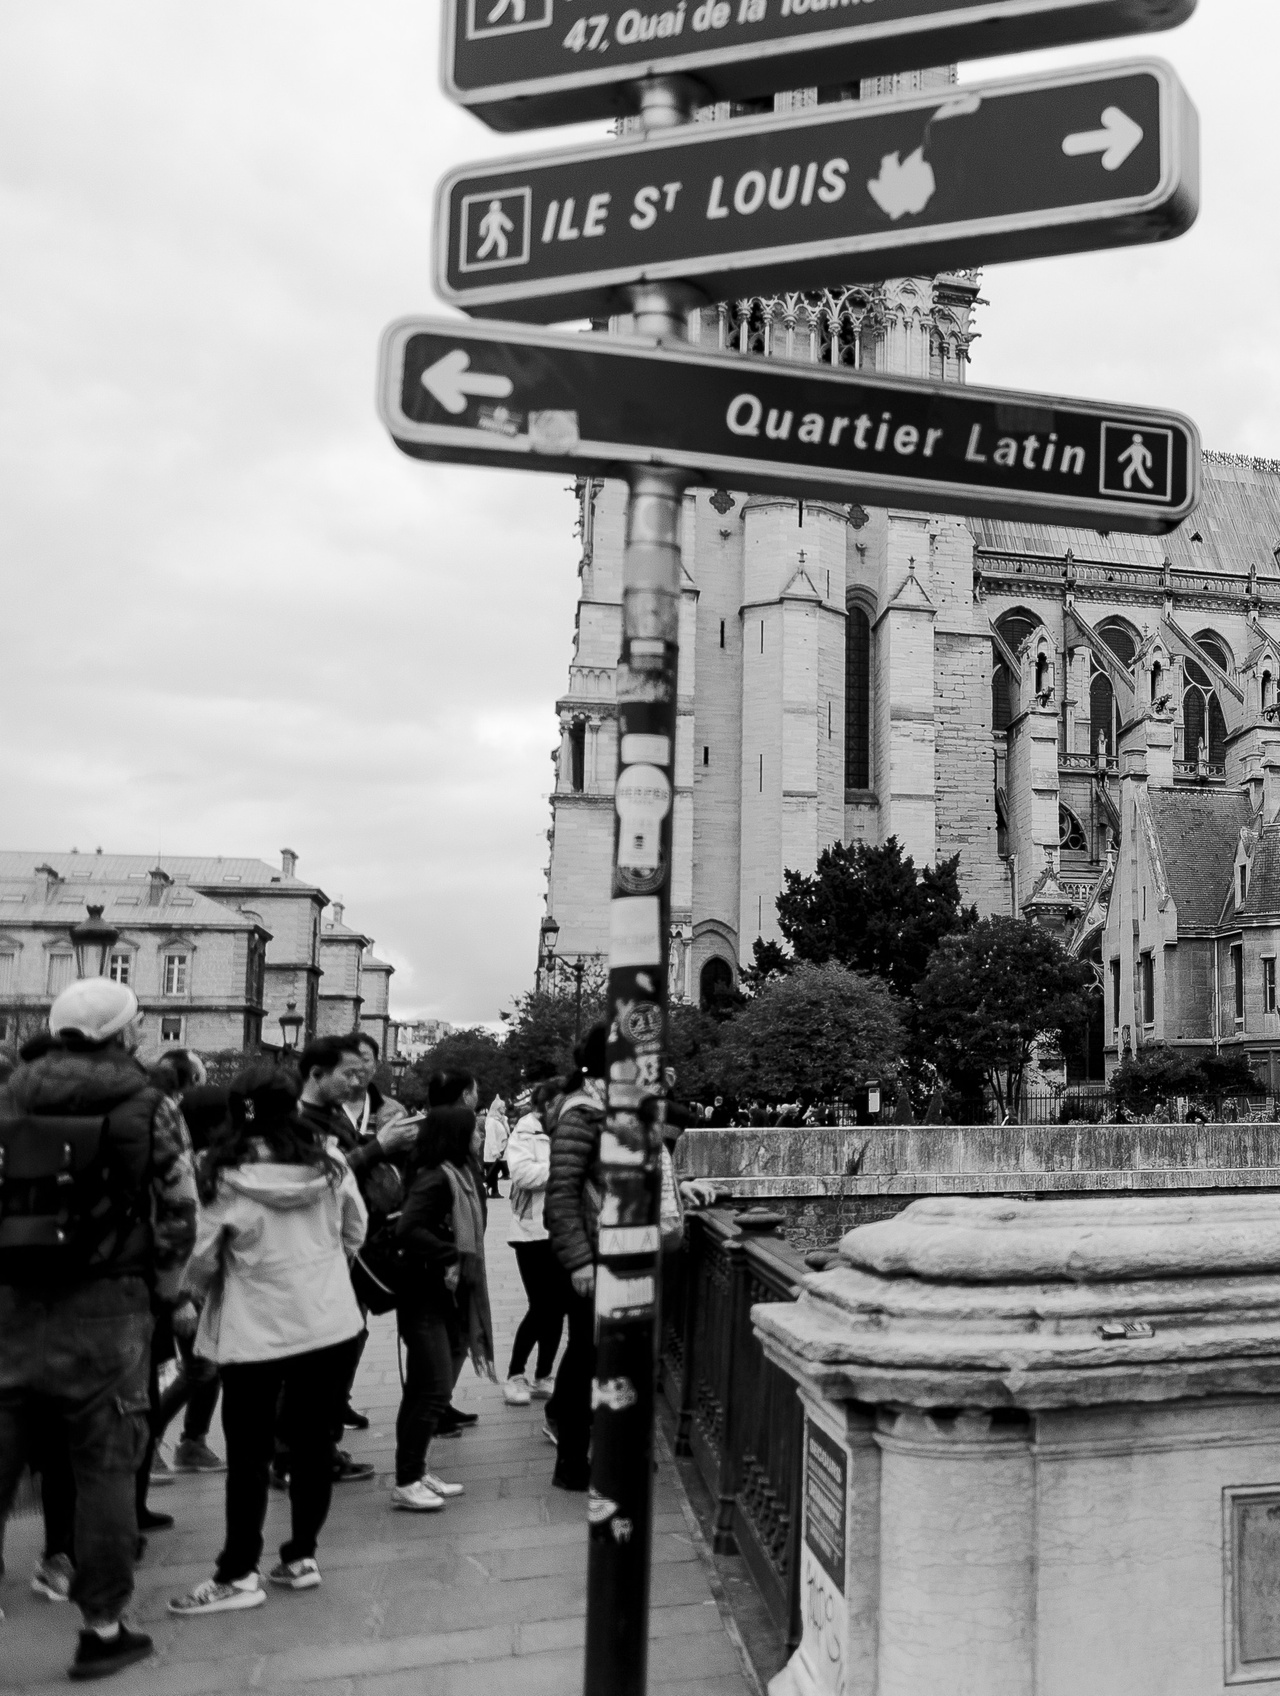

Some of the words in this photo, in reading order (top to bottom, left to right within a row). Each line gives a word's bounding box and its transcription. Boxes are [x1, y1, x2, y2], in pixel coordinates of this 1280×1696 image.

[562, 13, 610, 53] 47,
[615, 0, 688, 45] Quai
[692, 0, 731, 32] de
[736, 0, 767, 25] la
[541, 191, 612, 243] ILE
[706, 157, 850, 220] LOUIS
[725, 393, 943, 457] Quartier
[965, 422, 1087, 475] Latin
